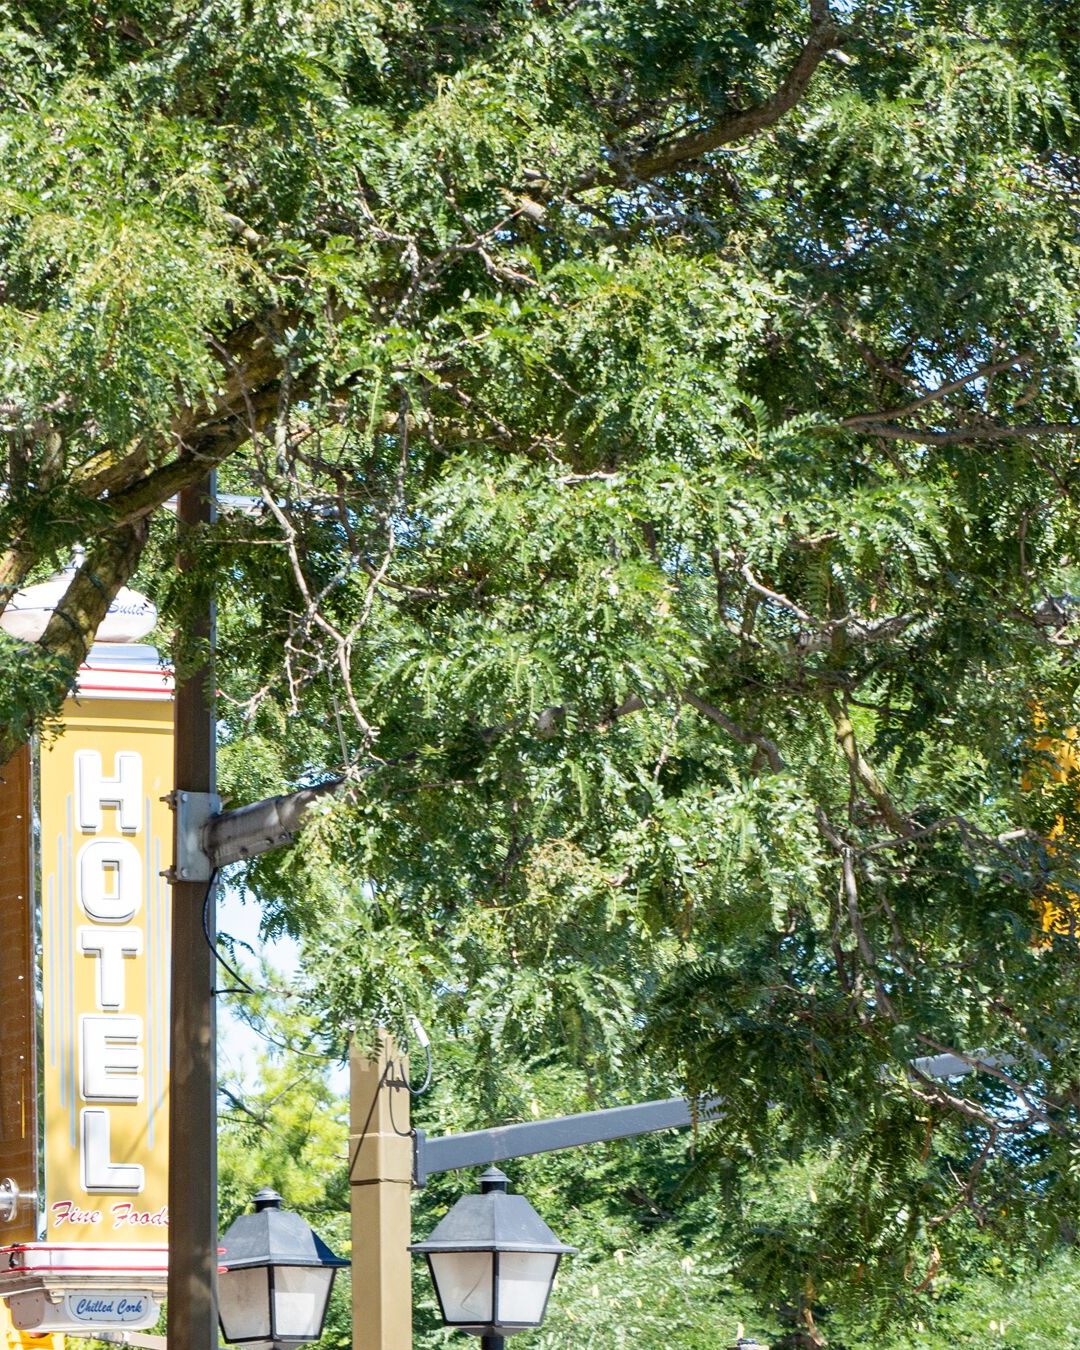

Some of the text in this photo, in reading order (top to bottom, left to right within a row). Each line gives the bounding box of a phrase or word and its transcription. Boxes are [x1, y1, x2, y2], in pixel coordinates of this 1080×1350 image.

[72, 749, 144, 1194] HOTEL
[51, 1201, 101, 1227] Fine
[76, 1299, 142, 1315] Chilled Cork
